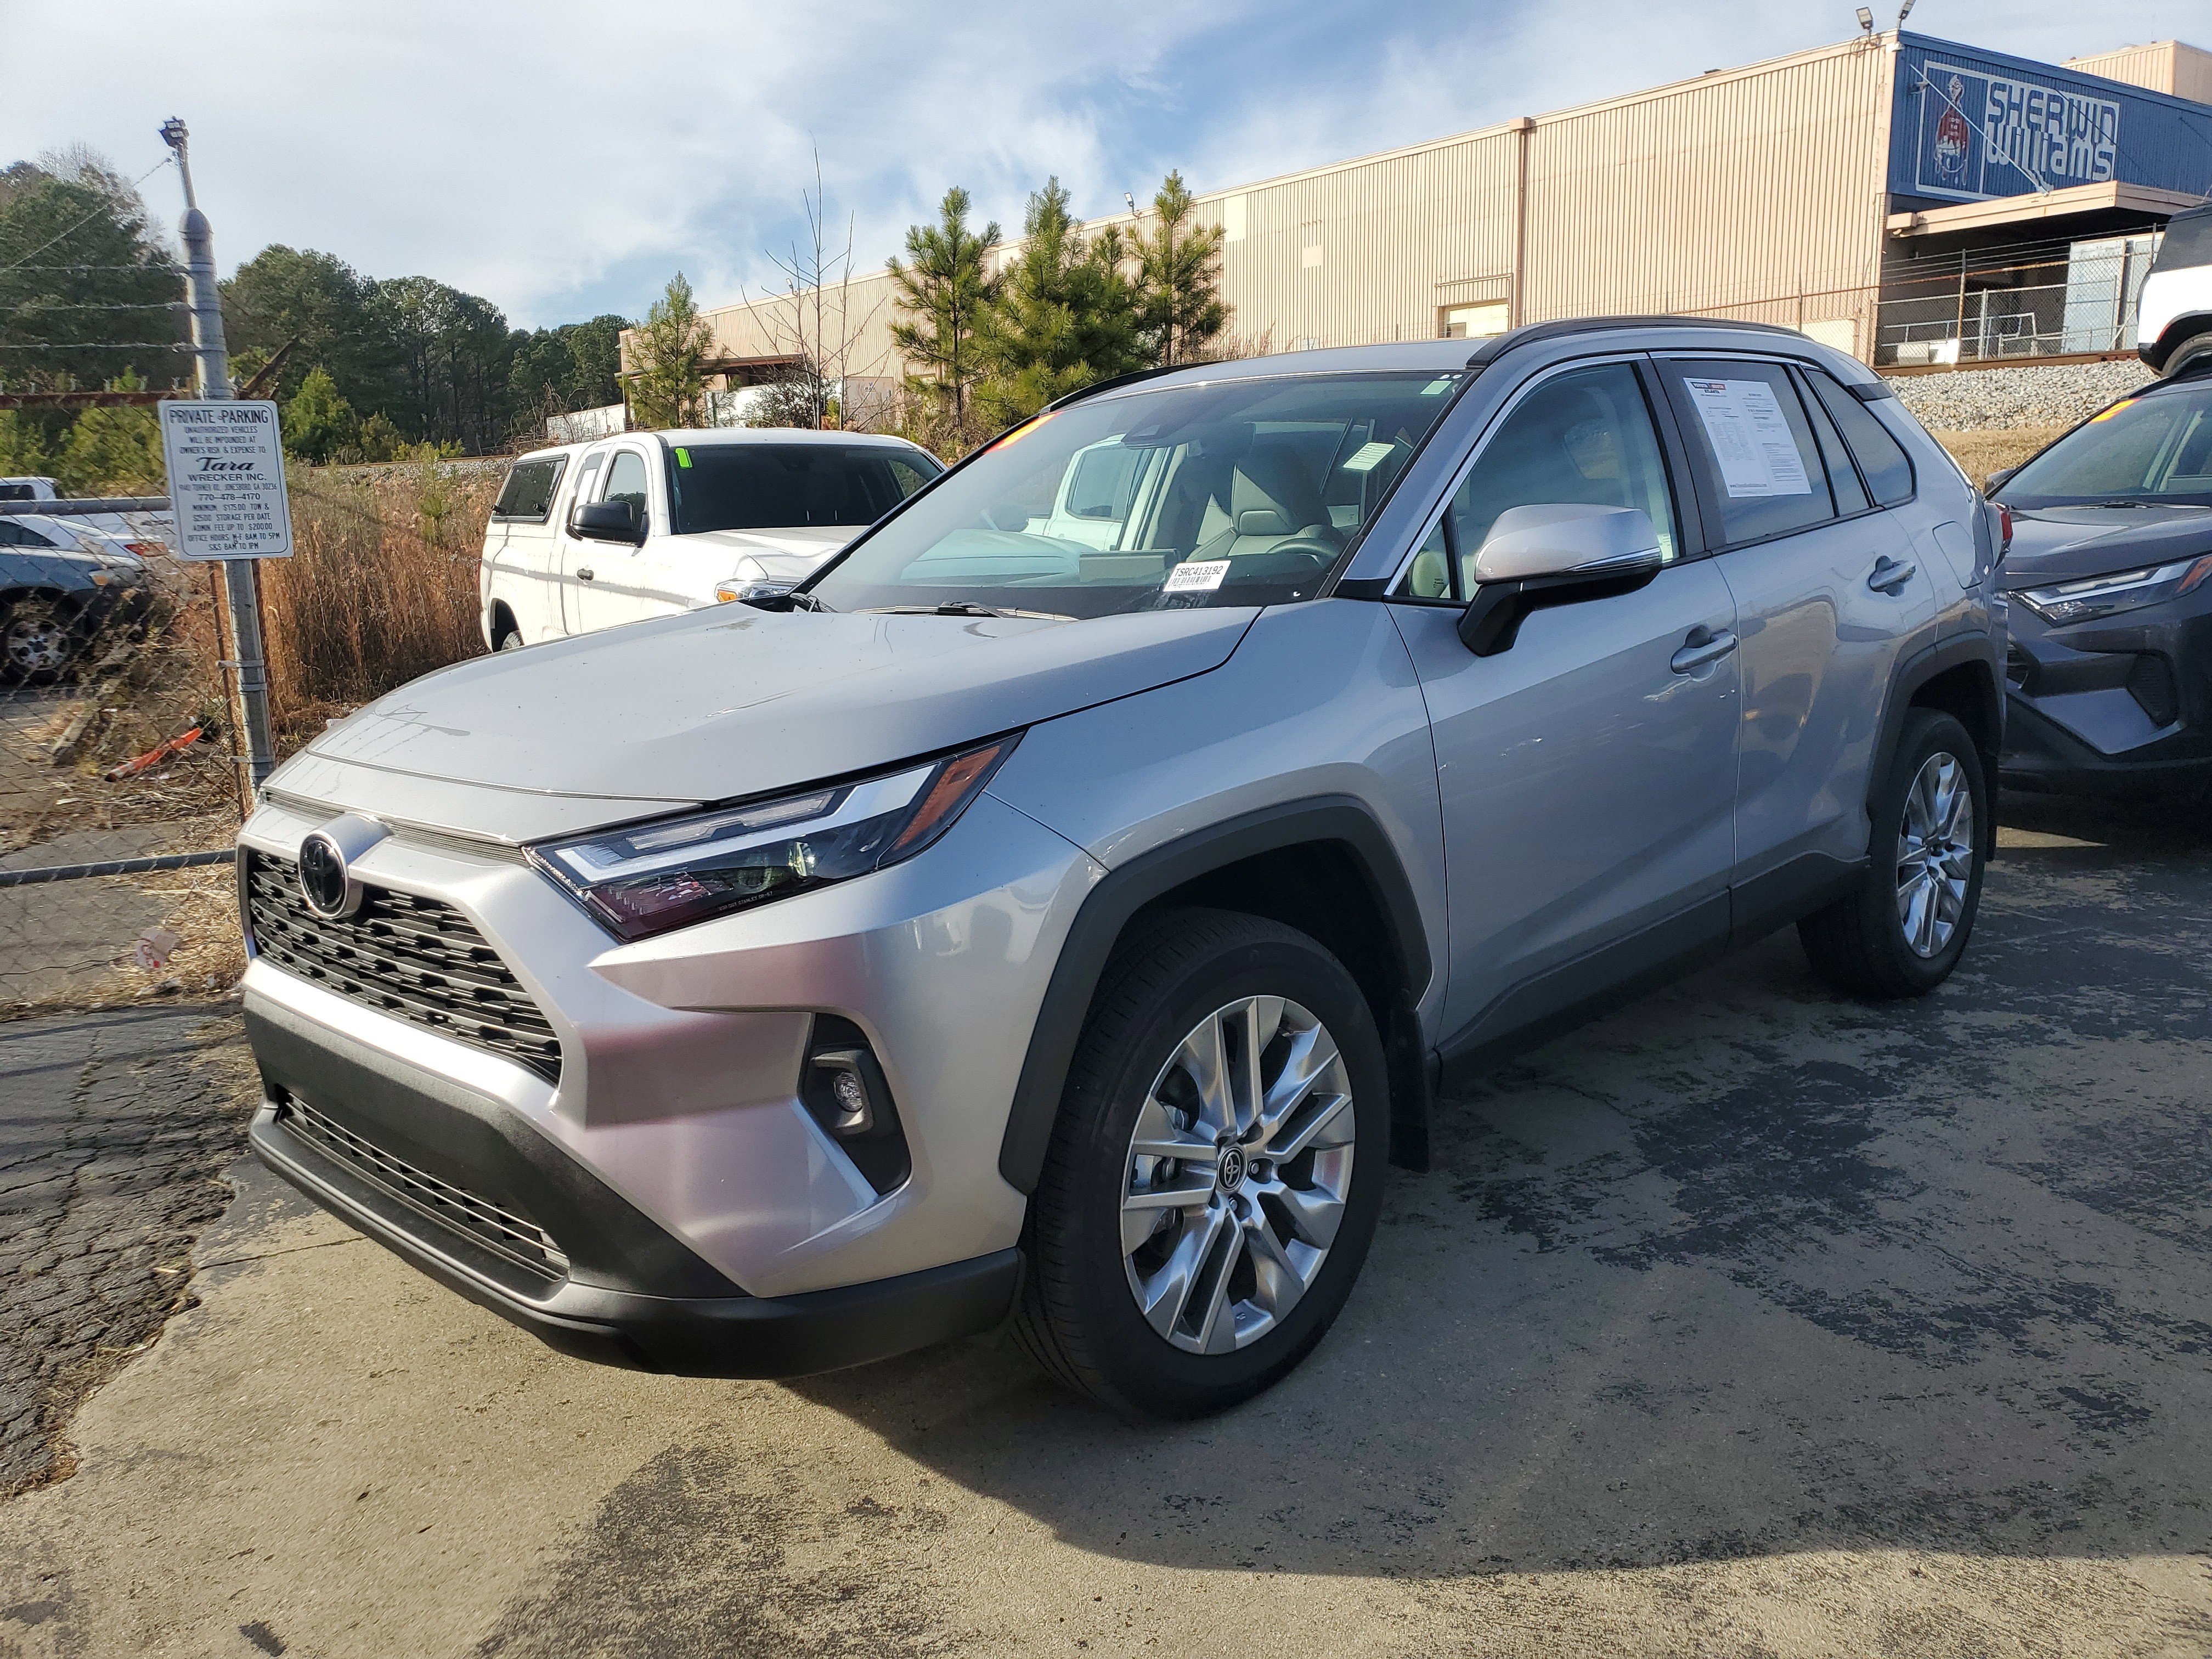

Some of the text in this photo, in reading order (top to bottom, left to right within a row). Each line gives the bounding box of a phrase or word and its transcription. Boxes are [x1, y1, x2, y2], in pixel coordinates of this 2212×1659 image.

[170, 409, 268, 424] PRIVATE PARKING
[195, 456, 256, 471] Tara
[187, 473, 267, 482] WRECKER INC.
[1175, 565, 1223, 577] TSRC413192
